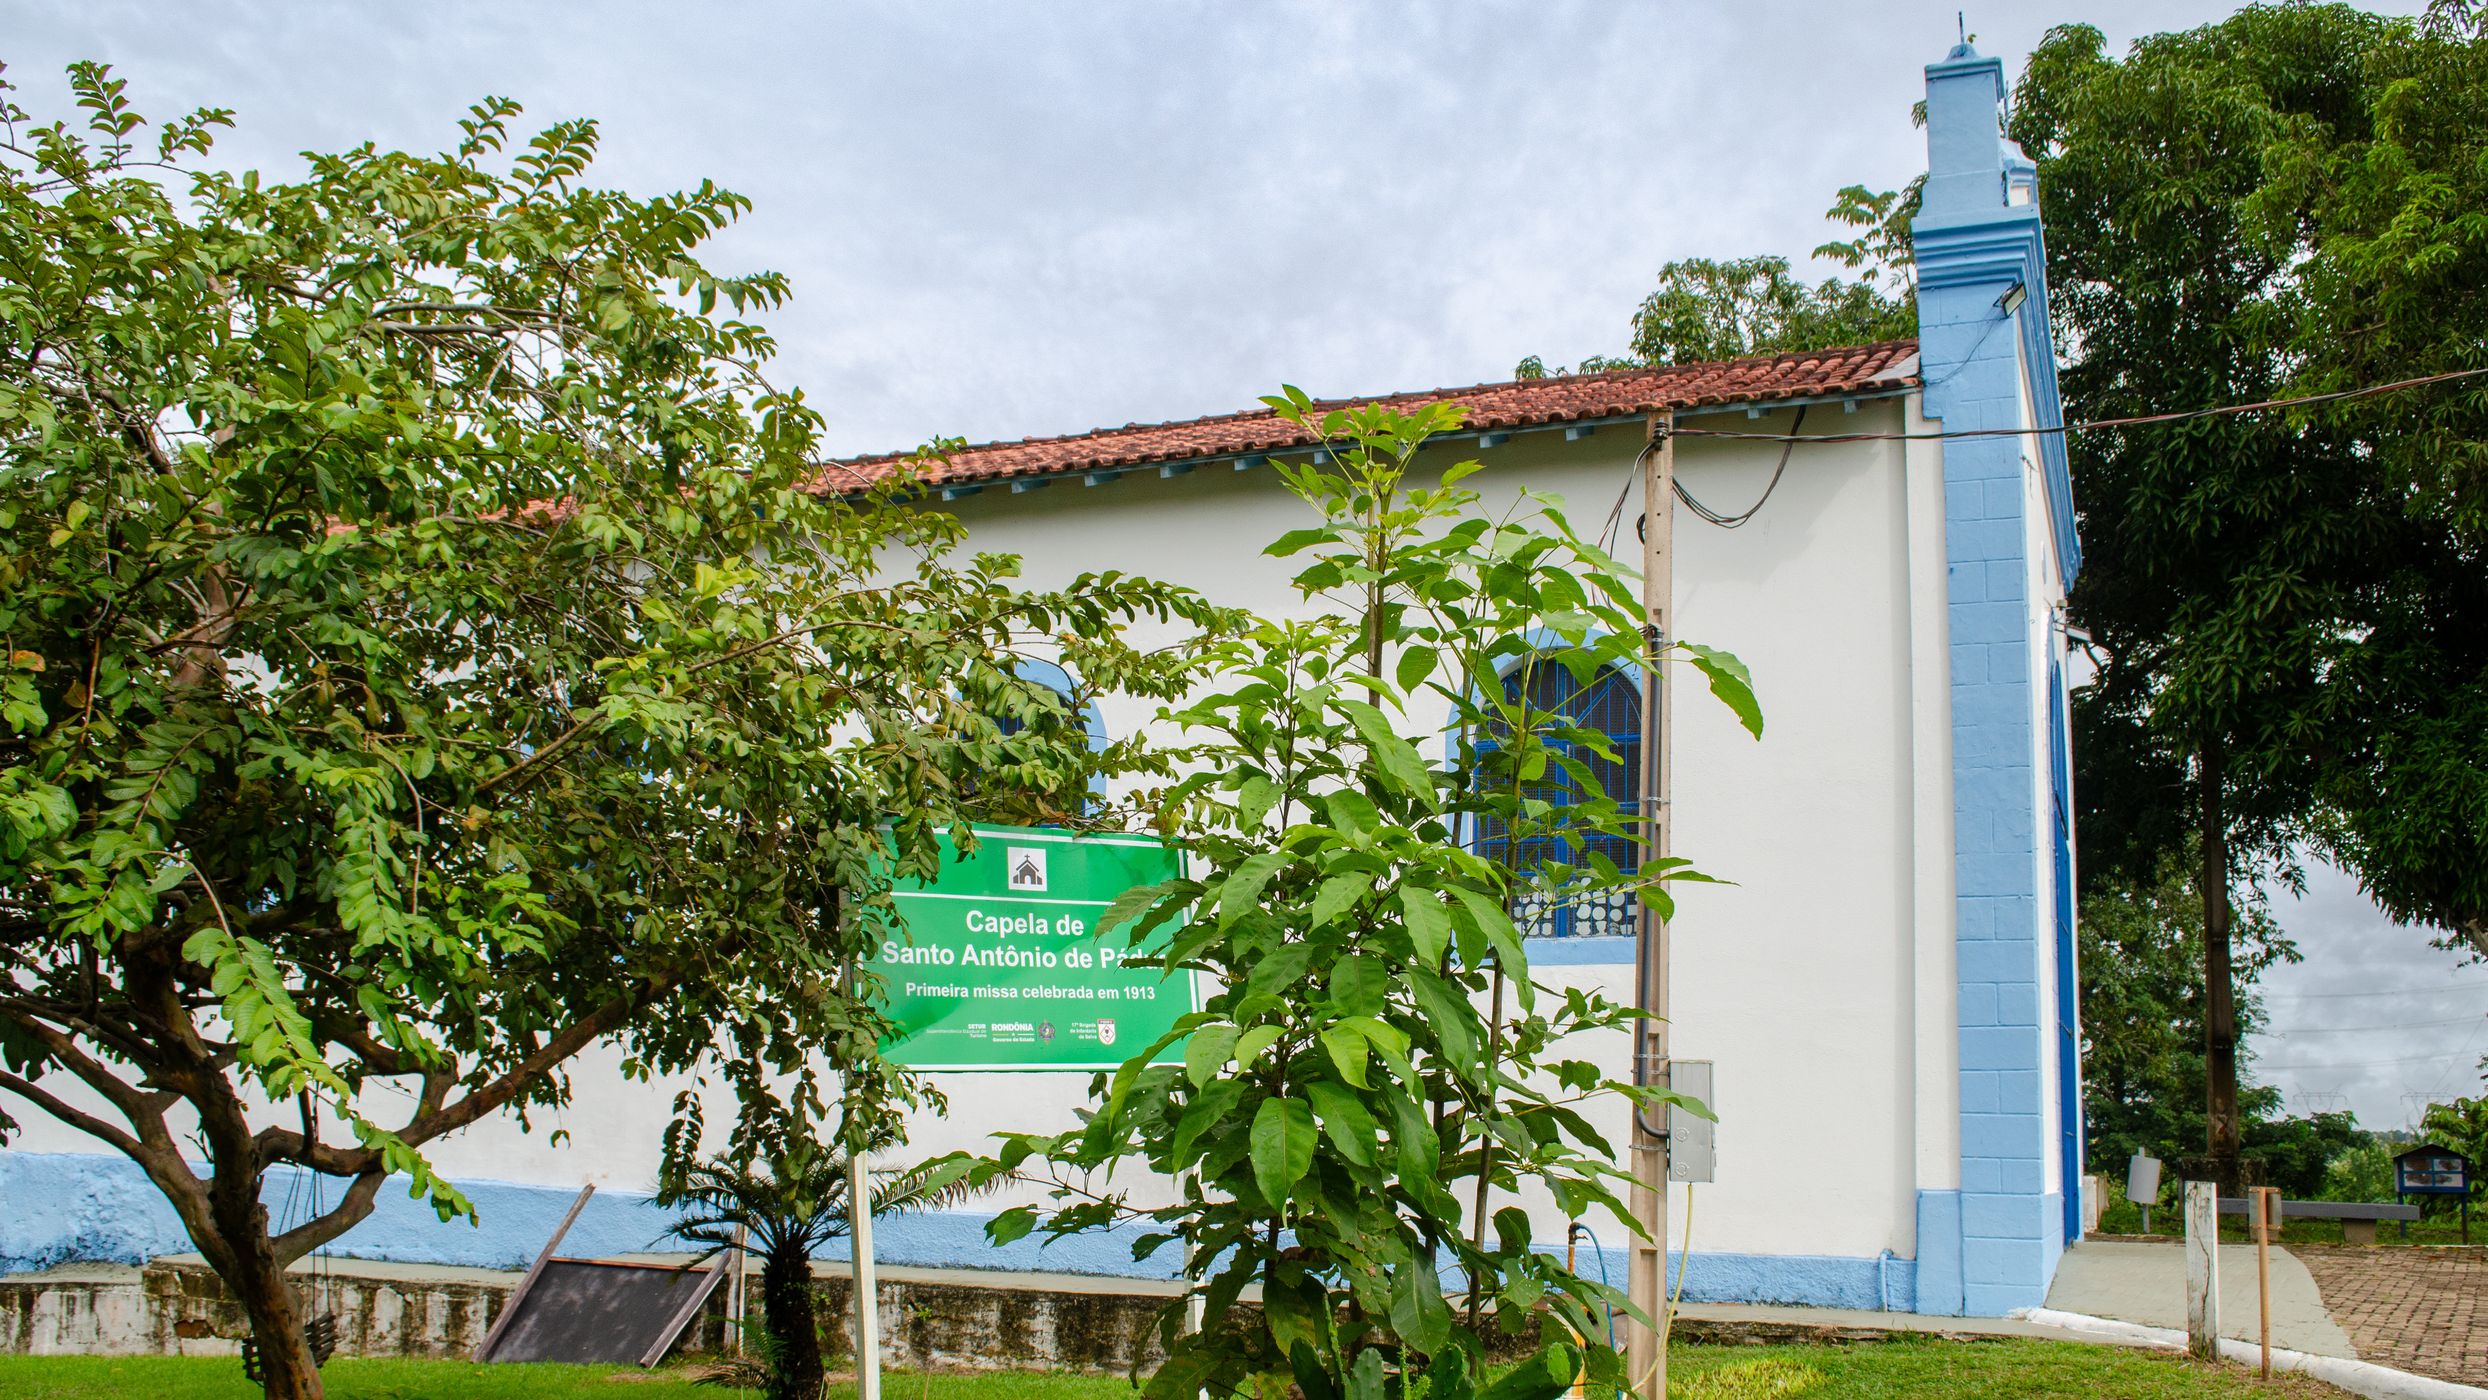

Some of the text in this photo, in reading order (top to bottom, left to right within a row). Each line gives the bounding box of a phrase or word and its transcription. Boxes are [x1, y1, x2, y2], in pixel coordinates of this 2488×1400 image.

[965, 909, 1084, 939] Capela de
[882, 940, 955, 965] Santo
[961, 943, 1057, 968] Antônio
[1064, 947, 1093, 969] de
[905, 982, 1155, 999] Primeira missa celebrada em 1913
[991, 1021, 1034, 1031] RONDÔNIA
